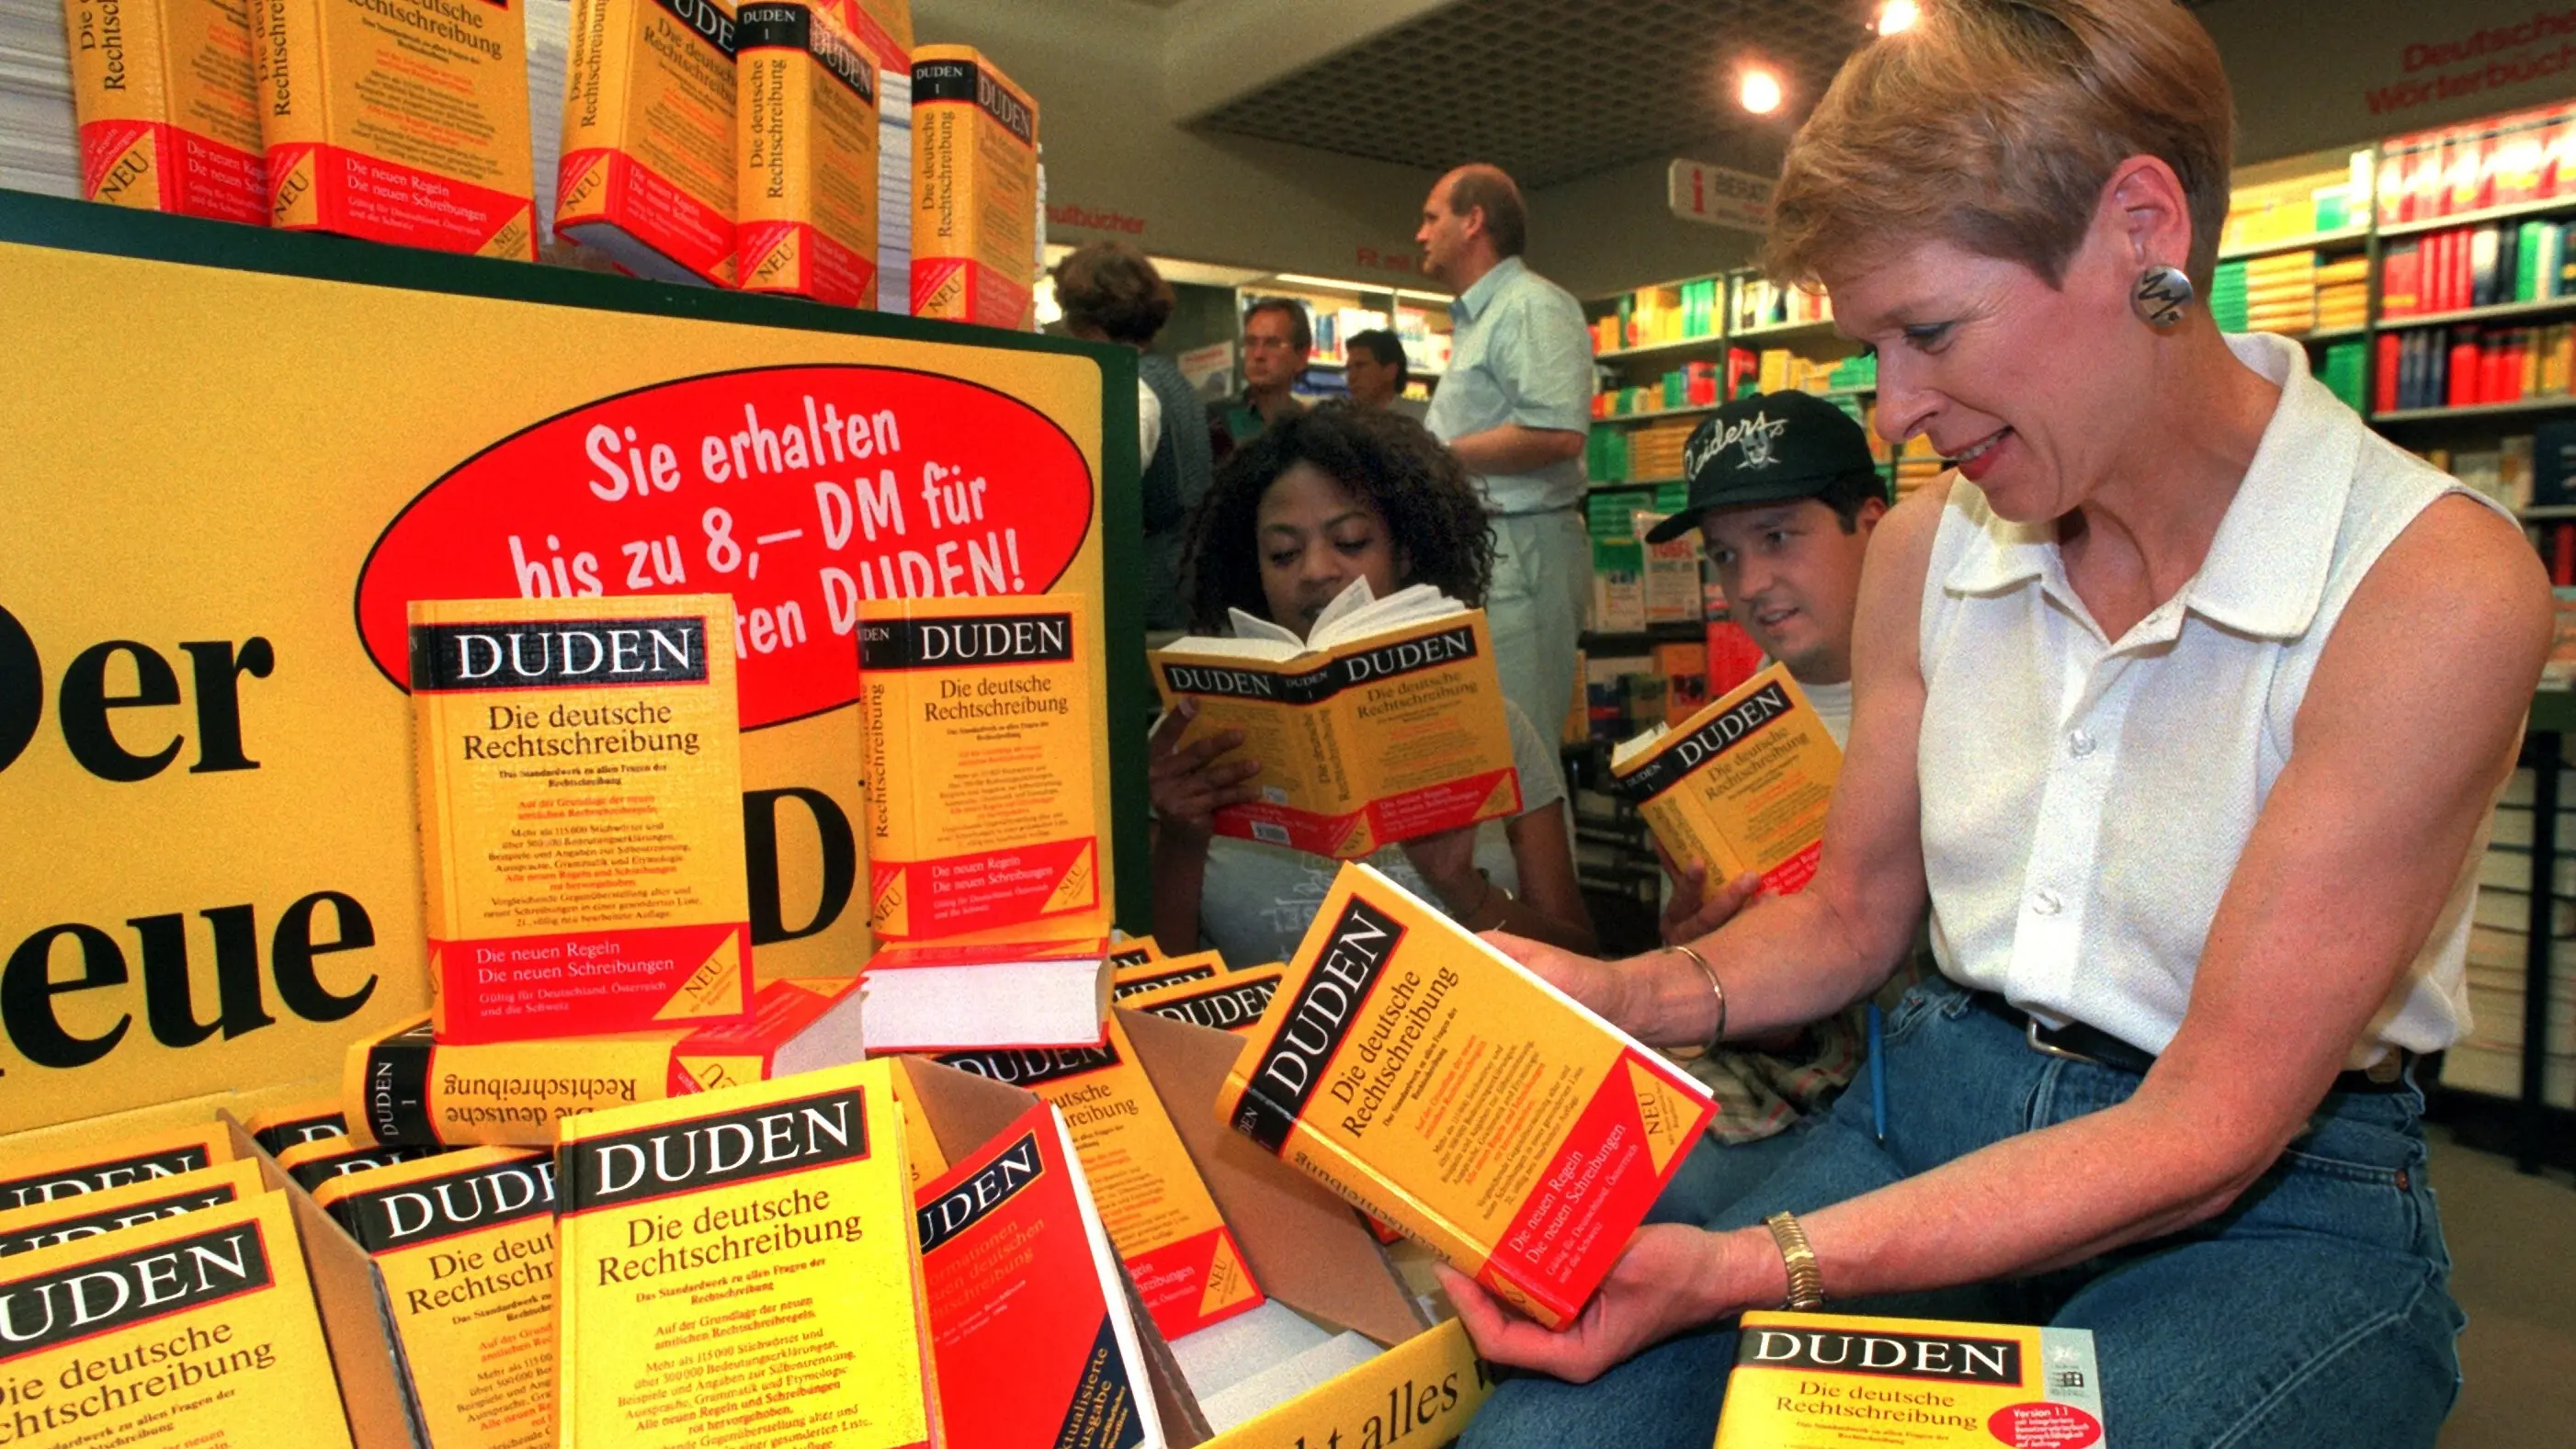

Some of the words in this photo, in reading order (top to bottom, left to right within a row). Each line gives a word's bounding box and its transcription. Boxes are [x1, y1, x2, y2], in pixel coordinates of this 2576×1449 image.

[81, 12, 96, 51] Die
[743, 10, 796, 25] DUDEN
[751, 59, 766, 127] deutsche
[916, 65, 964, 80] DUDEN
[750, 132, 765, 169] Die
[768, 58, 787, 199] Rechtschreibung
[924, 111, 936, 177] deutsche
[101, 151, 150, 202] NEU
[346, 156, 368, 175] Die
[371, 166, 406, 187] neuen
[412, 175, 449, 198] Regeln
[566, 170, 603, 212] NEU
[923, 179, 935, 211] Die
[936, 109, 955, 238] Rechtschreibung
[274, 172, 310, 221] NEU
[347, 175, 369, 192] Die
[372, 182, 408, 202] neuen
[412, 192, 487, 223] Schreibungen
[494, 223, 518, 249] NEU
[758, 243, 796, 284] NEU
[928, 277, 963, 316] NEU
[586, 424, 682, 503] Sie
[702, 395, 901, 482] erhalten
[509, 535, 603, 599] bis
[626, 531, 686, 589] zu
[815, 470, 905, 551] DM
[923, 463, 989, 531] für
[454, 628, 695, 680] DUDEN
[920, 619, 1065, 660] DUDEN
[1345, 631, 1470, 682] DUDEN
[939, 678, 971, 698] Die
[976, 674, 1051, 696] deutsche
[1171, 667, 1274, 696] DUDEN
[1367, 686, 1393, 703] Die
[488, 704, 540, 730] Die
[548, 699, 673, 729] deutsche
[924, 694, 1069, 722] Rechtschreibung
[1675, 683, 1787, 769] DUDEN
[462, 728, 701, 762] Rechtschreibung
[871, 684, 890, 839] Rechtschreibung
[874, 887, 903, 931] NEU
[476, 947, 504, 964] Die
[510, 945, 561, 961] neuen
[565, 939, 620, 961] Regeln
[478, 967, 506, 983] Die
[513, 964, 562, 980] neuen
[567, 956, 675, 979] Schreibungen
[684, 958, 724, 999] NEU
[1265, 909, 1390, 1095] DUDEN
[1331, 1078, 1365, 1108] Die
[1360, 969, 1422, 1070] deutsche
[1343, 966, 1458, 1138] Rechtschreibung
[372, 1060, 401, 1138] DUDEN
[443, 1073, 637, 1102] Rechtschreibung
[447, 1105, 549, 1128] deutsche
[1640, 1091, 1663, 1136] NEU
[596, 1101, 850, 1196] DUDEN
[1508, 1228, 1529, 1255] Die
[1526, 1187, 1558, 1230] neuen
[1553, 1150, 1583, 1192] Regeln
[1526, 1237, 1549, 1264] Die
[1541, 1204, 1575, 1242] neuen
[1571, 1122, 1627, 1207] Schreibungen
[628, 1217, 683, 1248] Die
[694, 1189, 831, 1233] deutsche
[428, 1251, 485, 1281] Die
[598, 1213, 862, 1286] Rechtschreibung
[635, 1289, 656, 1304] Das
[659, 1277, 728, 1297] Standardwerk
[772, 1259, 808, 1278] Fragen
[809, 1256, 825, 1268] der
[690, 1282, 774, 1305] Rechtschreibung
[1208, 1257, 1230, 1294] NEU
[653, 1321, 677, 1341] Auf
[678, 1318, 697, 1333] der
[699, 1307, 758, 1326] Grundlage
[759, 1301, 777, 1316] der
[779, 1295, 813, 1312] neuen
[654, 1331, 709, 1350] amtlichen
[1753, 1330, 2009, 1377] DUDEN
[0, 1376, 45, 1406] ie
[59, 1323, 233, 1389] deutsche
[136, 1410, 169, 1427] allen
[171, 1395, 214, 1415] Fragen
[215, 1387, 237, 1402] der
[635, 1415, 663, 1433] Alle
[664, 1409, 696, 1428] neuen
[699, 1399, 738, 1418] Regeln
[740, 1394, 763, 1411] und
[766, 1380, 841, 1405] Schreibungen
[1363, 1368, 1458, 1449] alles
[1775, 1395, 1979, 1432] Rechtschreibung
[1799, 1380, 1842, 1399] Die
[1847, 1387, 1956, 1409] deutsche
